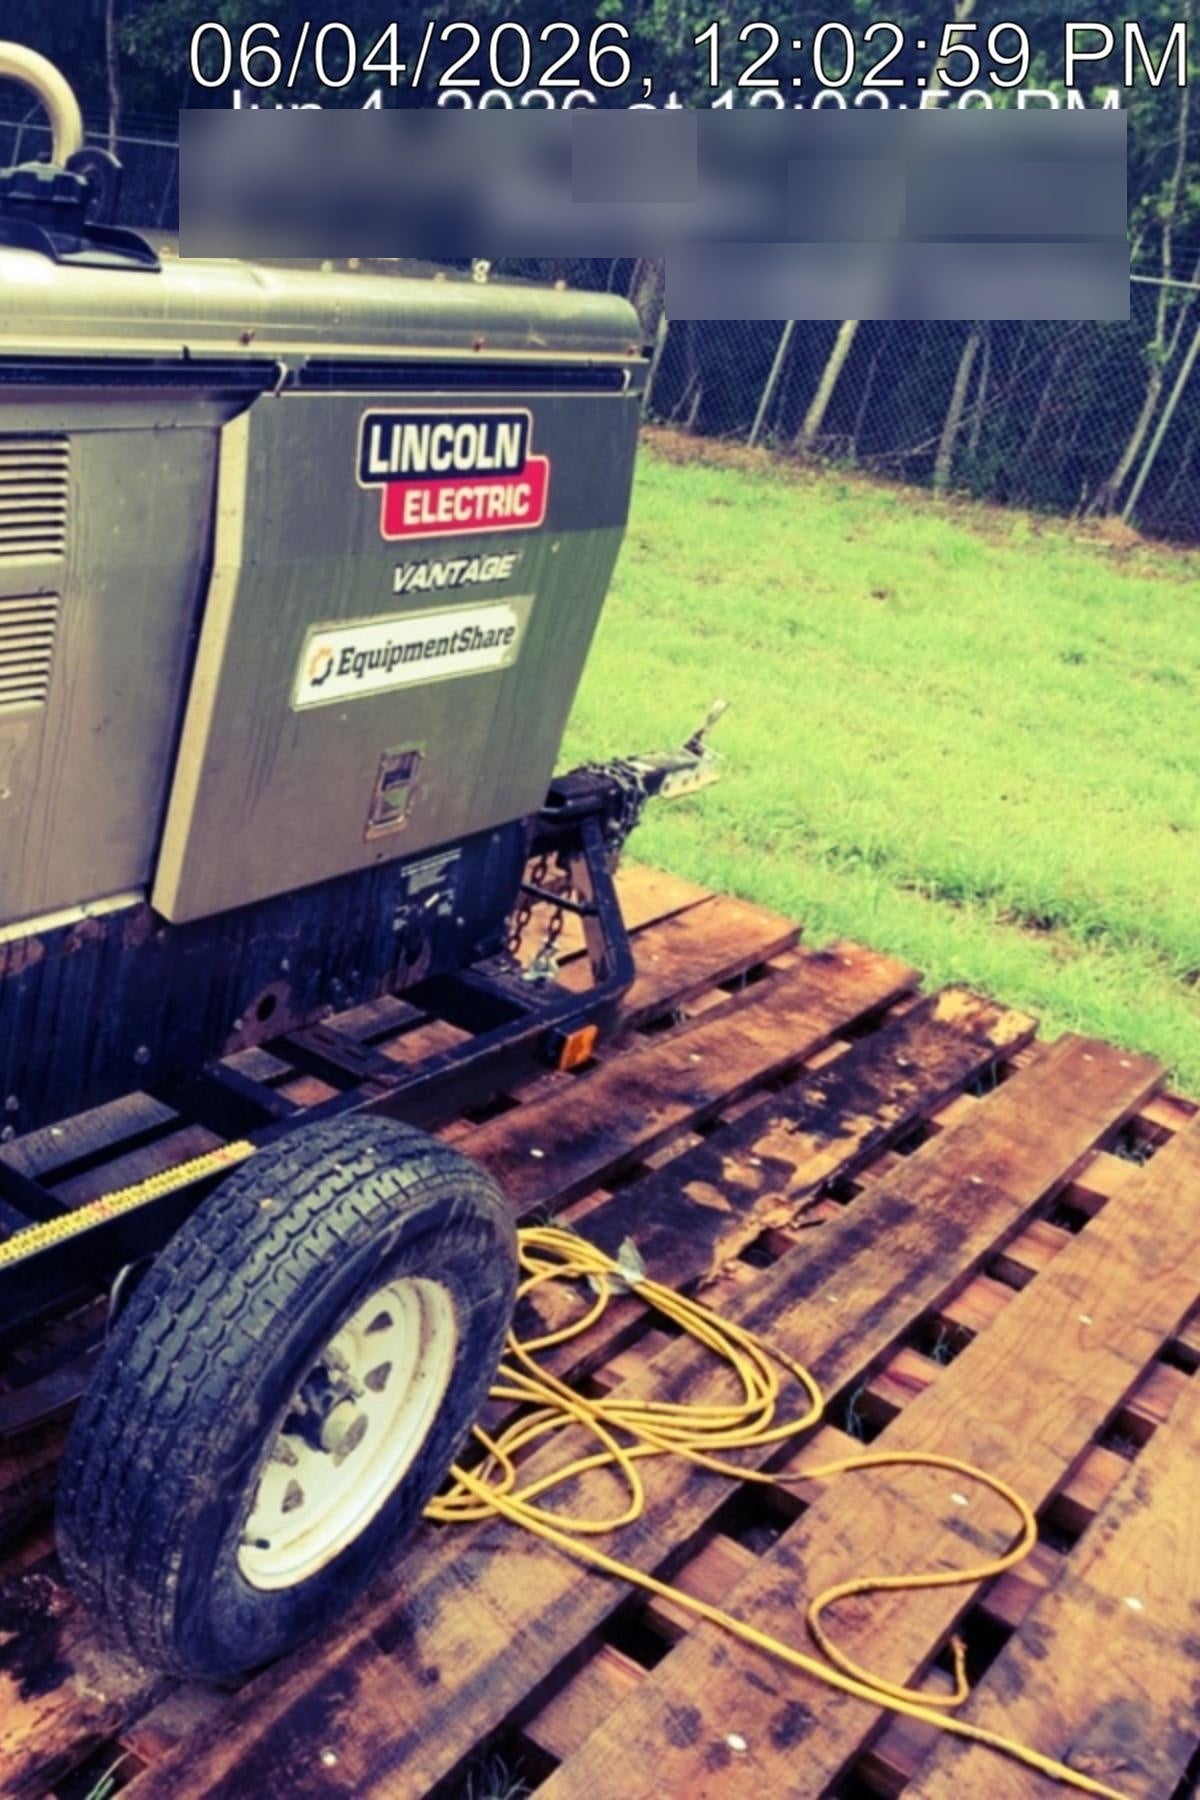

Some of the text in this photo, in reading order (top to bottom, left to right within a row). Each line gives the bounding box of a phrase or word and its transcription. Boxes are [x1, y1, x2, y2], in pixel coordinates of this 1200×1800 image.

[368, 422, 522, 474] LINCOLN
[402, 483, 531, 526] ELECTRIC
[392, 554, 517, 594] VANTAGE
[335, 625, 516, 679] EquipmentShare
